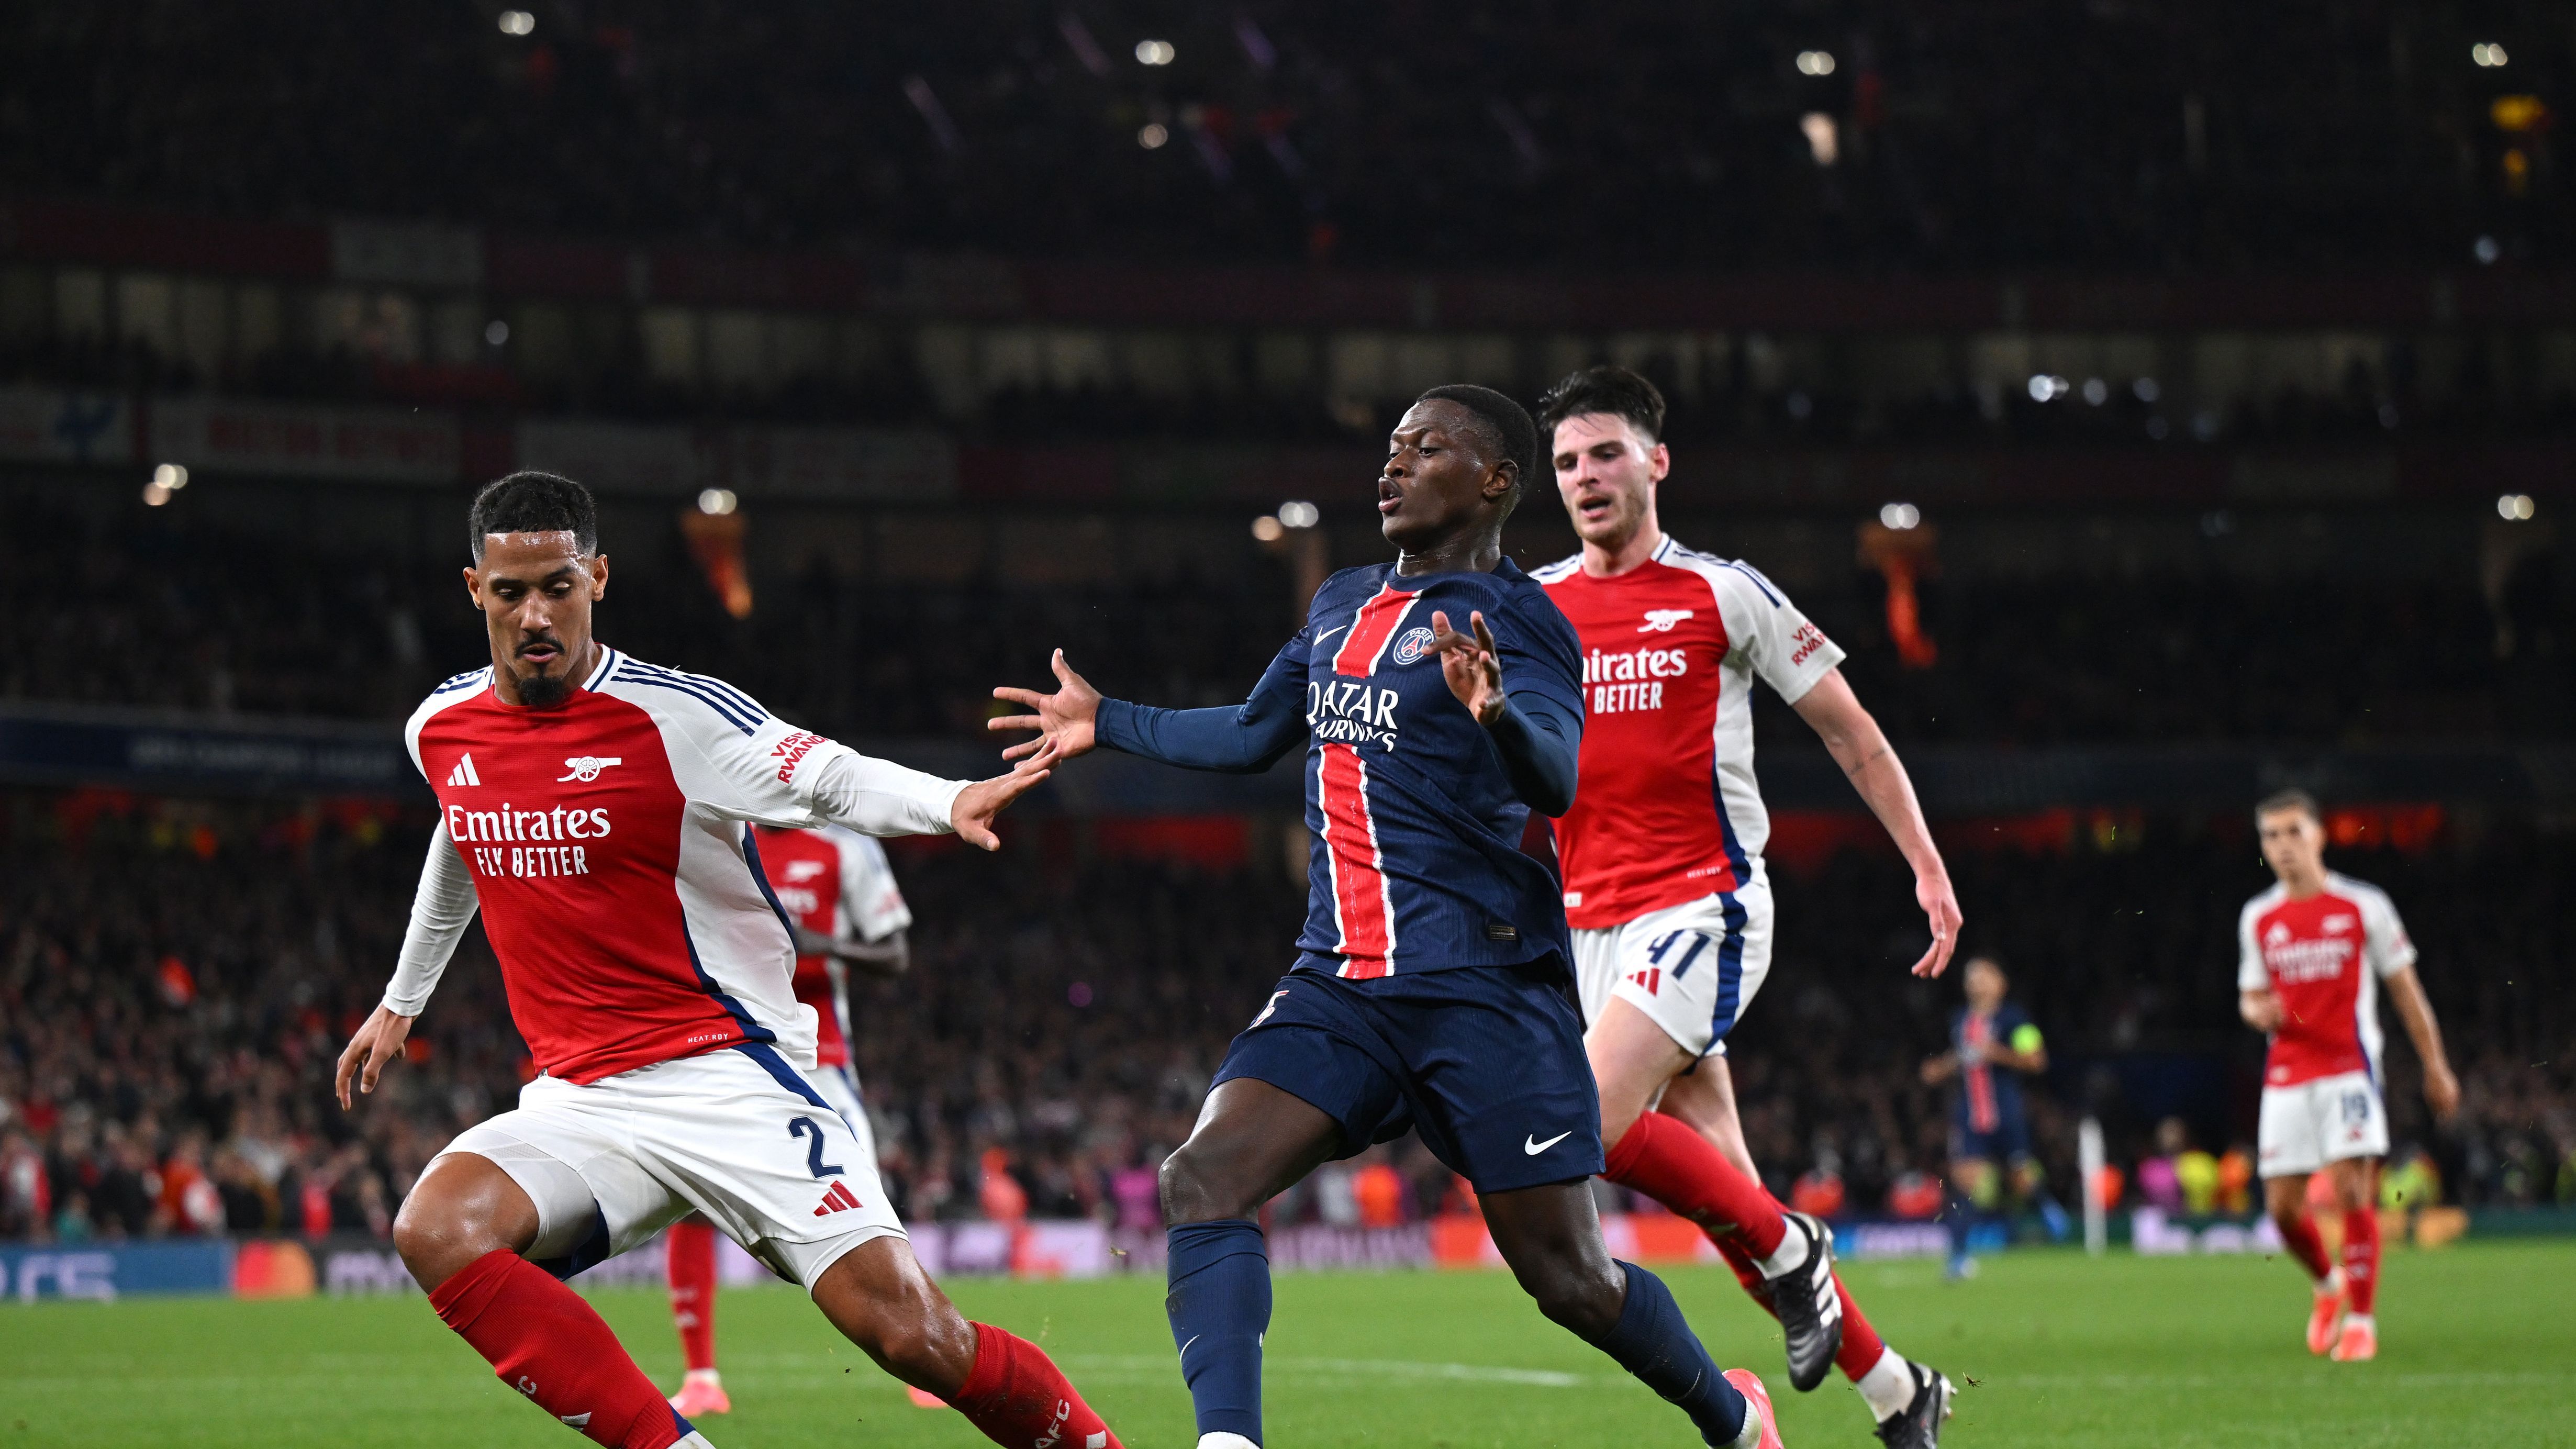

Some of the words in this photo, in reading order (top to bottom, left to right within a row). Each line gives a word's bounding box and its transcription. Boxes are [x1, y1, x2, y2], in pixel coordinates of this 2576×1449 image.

[1409, 630, 1432, 641] PARIS
[1792, 621, 1815, 642] VIS
[1583, 647, 1688, 684] irates
[1306, 680, 1399, 730] QATAR
[1594, 681, 1663, 715] BETTER
[449, 802, 611, 842] Emirates
[474, 846, 504, 877] FLY
[512, 845, 589, 878] BETTER
[688, 1033, 728, 1043] HEAT.RDY
[786, 1115, 846, 1180] 2
